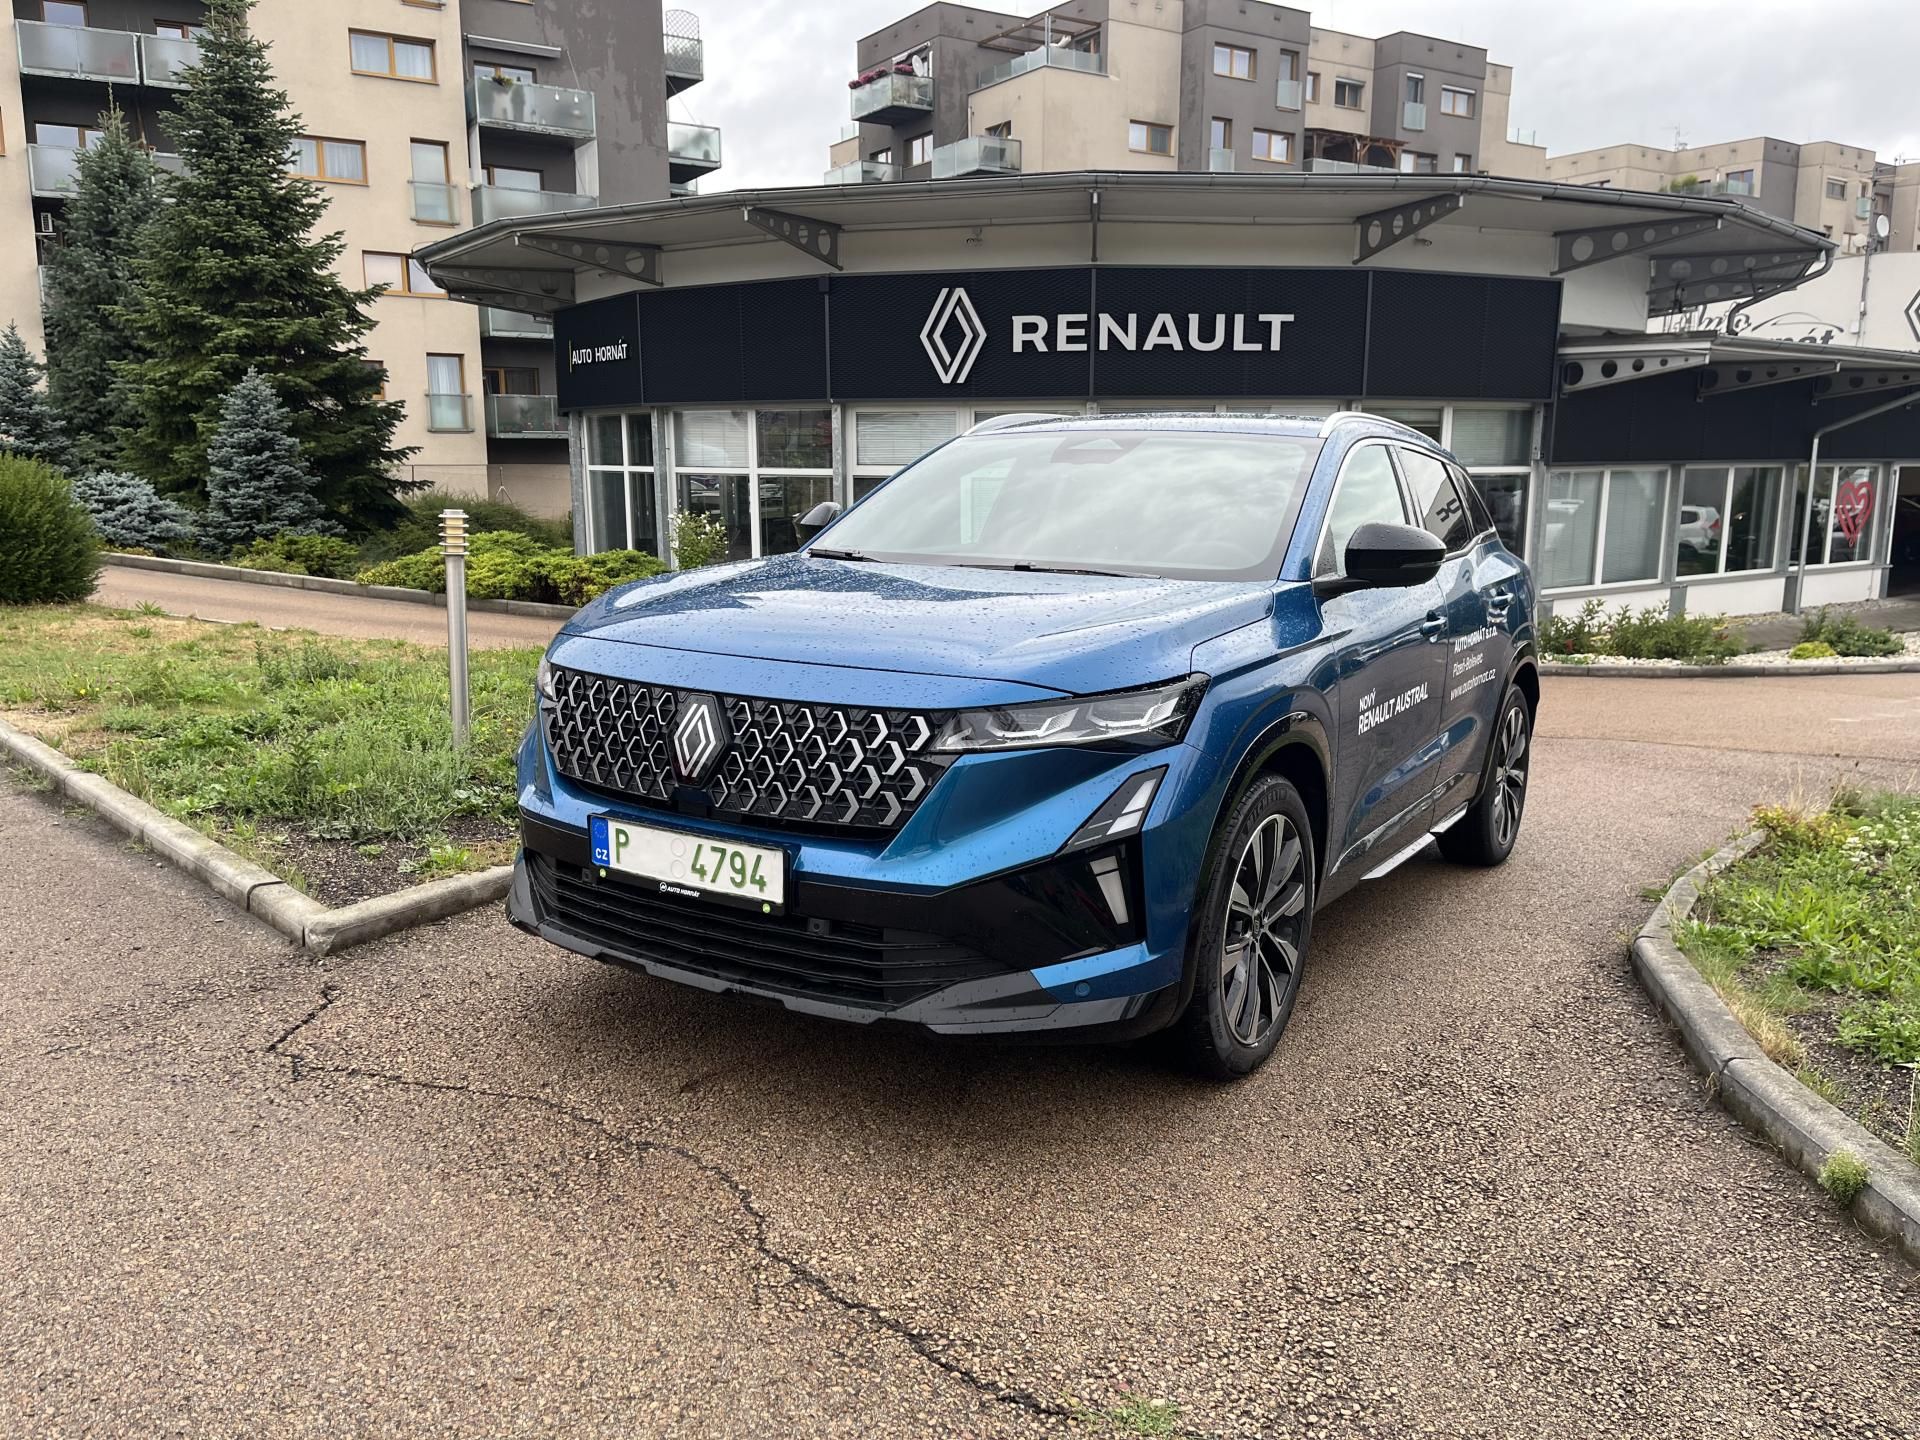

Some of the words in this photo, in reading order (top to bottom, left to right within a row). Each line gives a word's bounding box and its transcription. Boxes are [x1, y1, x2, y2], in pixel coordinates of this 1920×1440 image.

[1011, 312, 1295, 353] RENAULT
[571, 348, 593, 365] AUTO
[594, 338, 628, 363] HORNÁT
[1453, 635, 1468, 654] AUTO
[1485, 625, 1499, 640] s.r.o.
[1358, 698, 1396, 735] RENAULT
[1394, 681, 1429, 715] AUSTRAL
[1359, 687, 1376, 713] NOVÝ
[595, 847, 609, 861] CZ
[614, 827, 630, 865] P
[690, 843, 767, 893] 4794
[666, 886, 681, 894] AUTO
